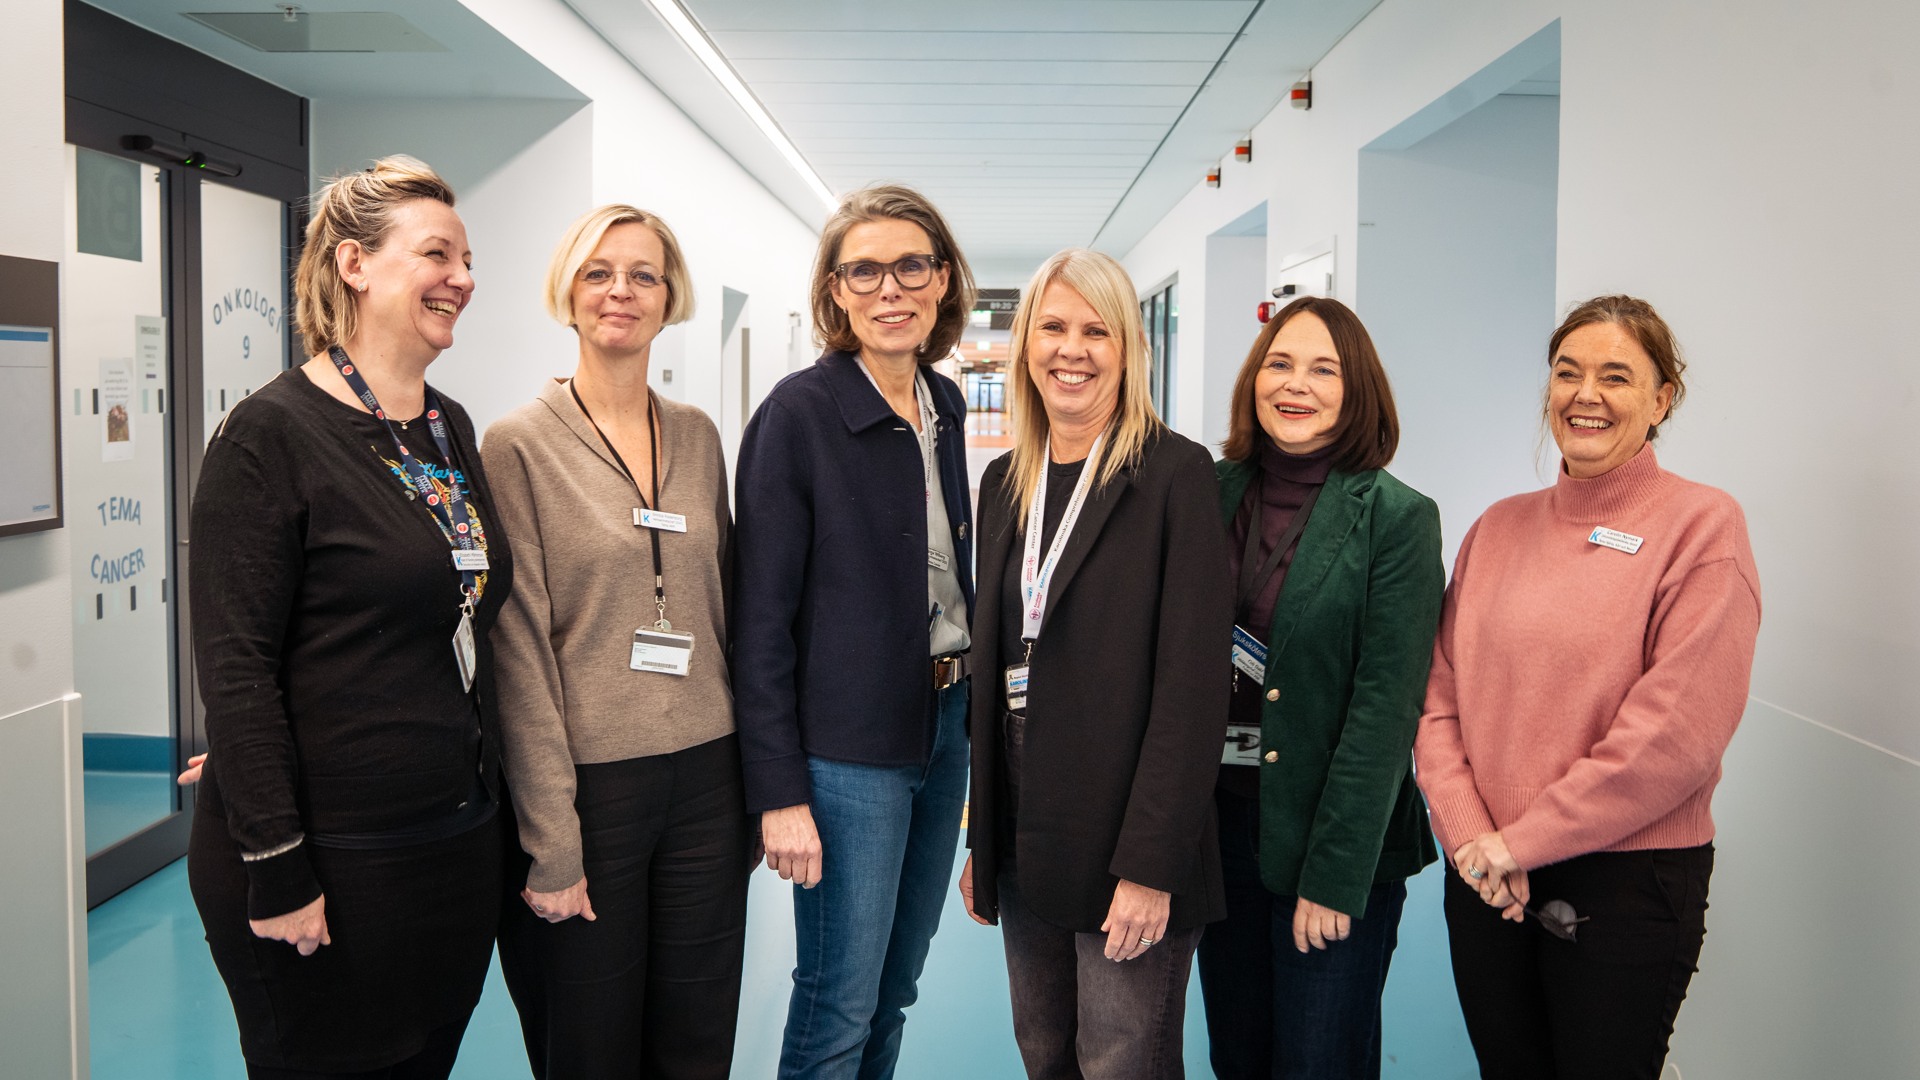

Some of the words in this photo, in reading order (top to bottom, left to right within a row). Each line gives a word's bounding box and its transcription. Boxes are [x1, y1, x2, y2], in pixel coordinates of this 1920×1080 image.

[213, 288, 282, 334] ONKOLOGI
[243, 335, 251, 359] 9
[97, 497, 141, 526] TEMA
[91, 548, 146, 584] CANCER
